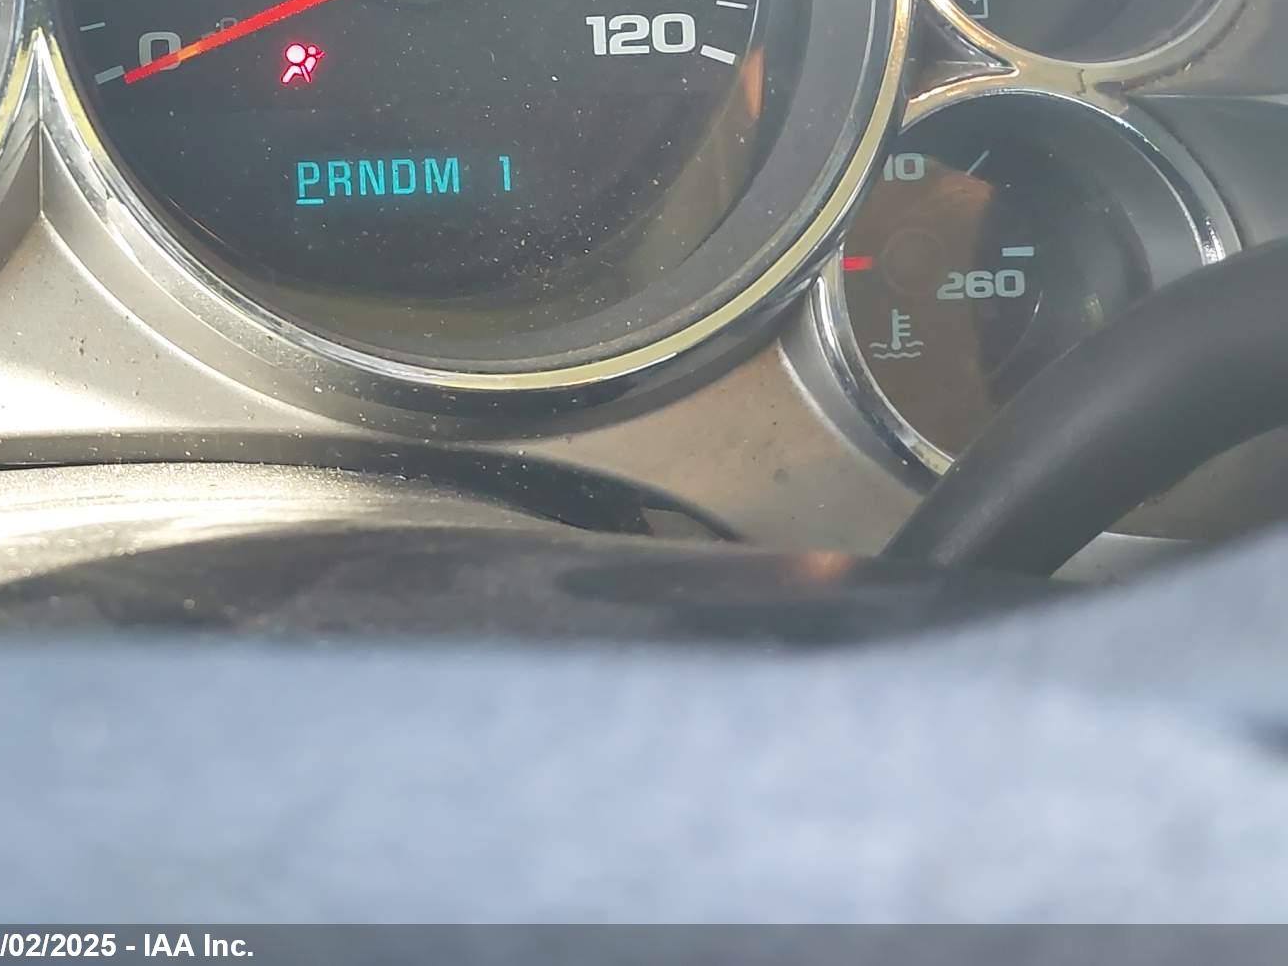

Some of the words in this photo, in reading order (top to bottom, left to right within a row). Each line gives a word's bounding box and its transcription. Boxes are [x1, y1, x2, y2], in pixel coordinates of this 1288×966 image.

[139, 32, 182, 70] 0
[586, 14, 695, 55] 120
[296, 157, 460, 199] PRNDM
[498, 155, 510, 191] 1
[937, 270, 1024, 299] 260
